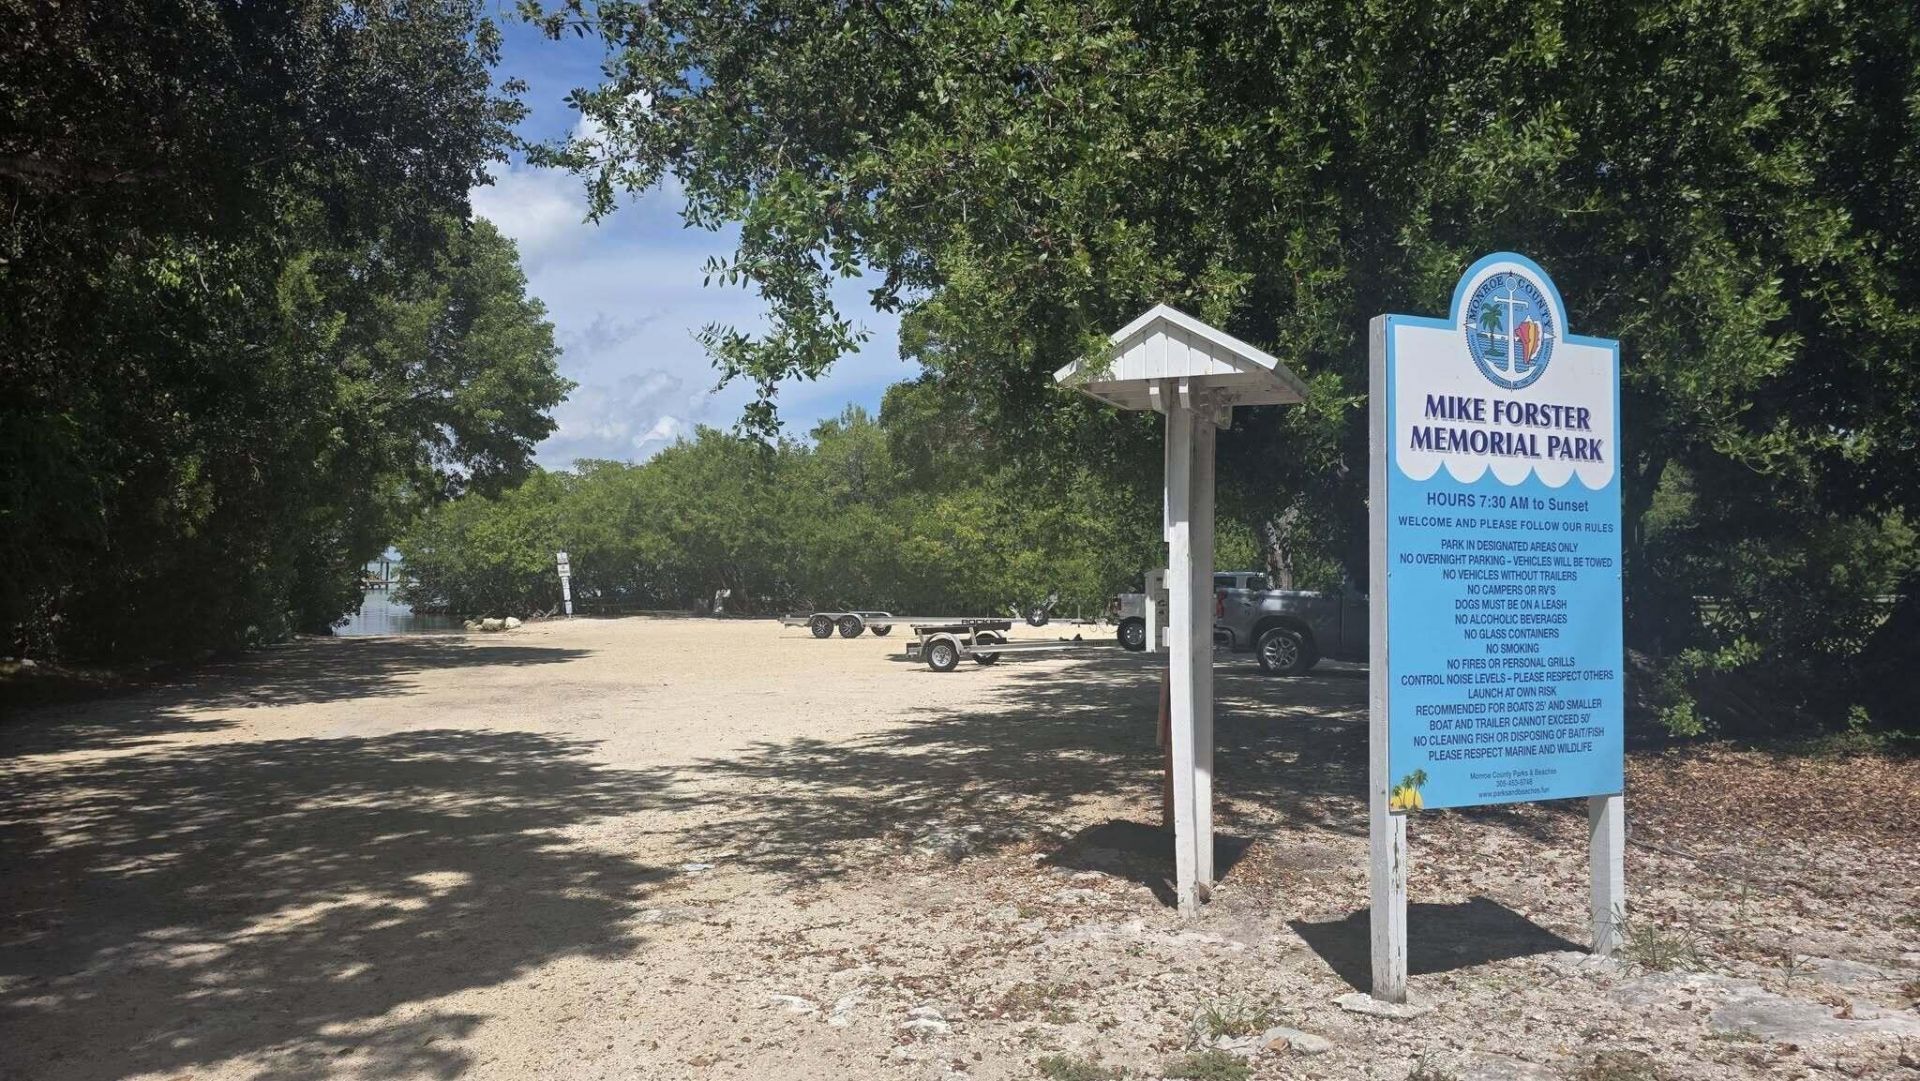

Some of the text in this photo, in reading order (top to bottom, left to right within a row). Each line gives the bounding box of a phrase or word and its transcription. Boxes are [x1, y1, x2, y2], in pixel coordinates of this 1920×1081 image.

[1468, 275, 1552, 328] MONROE COUNTY
[1424, 393, 1591, 431] MIKE FORSTER
[1410, 425, 1604, 462] MEMORIAL PARK
[1427, 492, 1589, 512] HOURS 7:30 AM to Sunset
[1398, 516, 1614, 533] WELCOME AND PLEASE FOLLOW OUR RULES
[1441, 539, 1579, 553] PARK IN DESIGNATED AREAS ONLY
[1400, 553, 1414, 564] NO
[1416, 553, 1467, 565] OVERNIGHT
[1468, 554, 1506, 566] PARKING
[1513, 555, 1552, 567] VEHICLES
[1553, 556, 1573, 567] WILL
[1573, 557, 1584, 567] BE
[1585, 557, 1613, 568] TOWED
[1443, 569, 1577, 581] NO VEHICLES WITHOUT TRAILERS
[1467, 584, 1480, 595] NO
[1482, 584, 1523, 595] CAMPERS
[1524, 585, 1537, 595] OR
[1455, 599, 1567, 610] DOGS MUST BE ON A LEASH
[1455, 614, 1568, 625] NO ALCOHOLIC BEVERAGES
[1464, 628, 1560, 640] NO GLASS CONTAINERS
[1486, 643, 1540, 654] NO SMOKING
[1447, 656, 1576, 669] NO FIRES OR PERSONAL GRILLS
[1401, 674, 1445, 686] CONTROL
[1446, 673, 1474, 685] NOISE
[1475, 673, 1506, 684] LEVELS
[1513, 672, 1545, 683] PLEASE
[1546, 671, 1582, 682] RESPECT
[1583, 670, 1614, 681] OTHERS
[1468, 686, 1557, 699] LAUNCH AT OWN RISK
[1416, 703, 1487, 716] RECOMMENDED
[1488, 702, 1506, 713] FOR
[1507, 701, 1534, 712] BOATS
[1548, 700, 1565, 711] AND
[1566, 698, 1602, 710] SMALLER
[1429, 720, 1453, 731] BOAT
[1455, 718, 1473, 730] AND
[1475, 717, 1511, 728] TRAILER
[1512, 715, 1547, 727] CANNOT
[1547, 714, 1579, 725] EXCEED
[1413, 727, 1605, 747] NO CLEANING FISH OR DISPOSING OF BAIT/FISH
[1428, 741, 1593, 761] PLEASE RESPECT MARINE AND WILDLIFE
[1470, 772, 1491, 780] Monroe
[1492, 771, 1512, 779] County
[1513, 769, 1529, 777] Parks
[1534, 767, 1557, 776] Beaches
